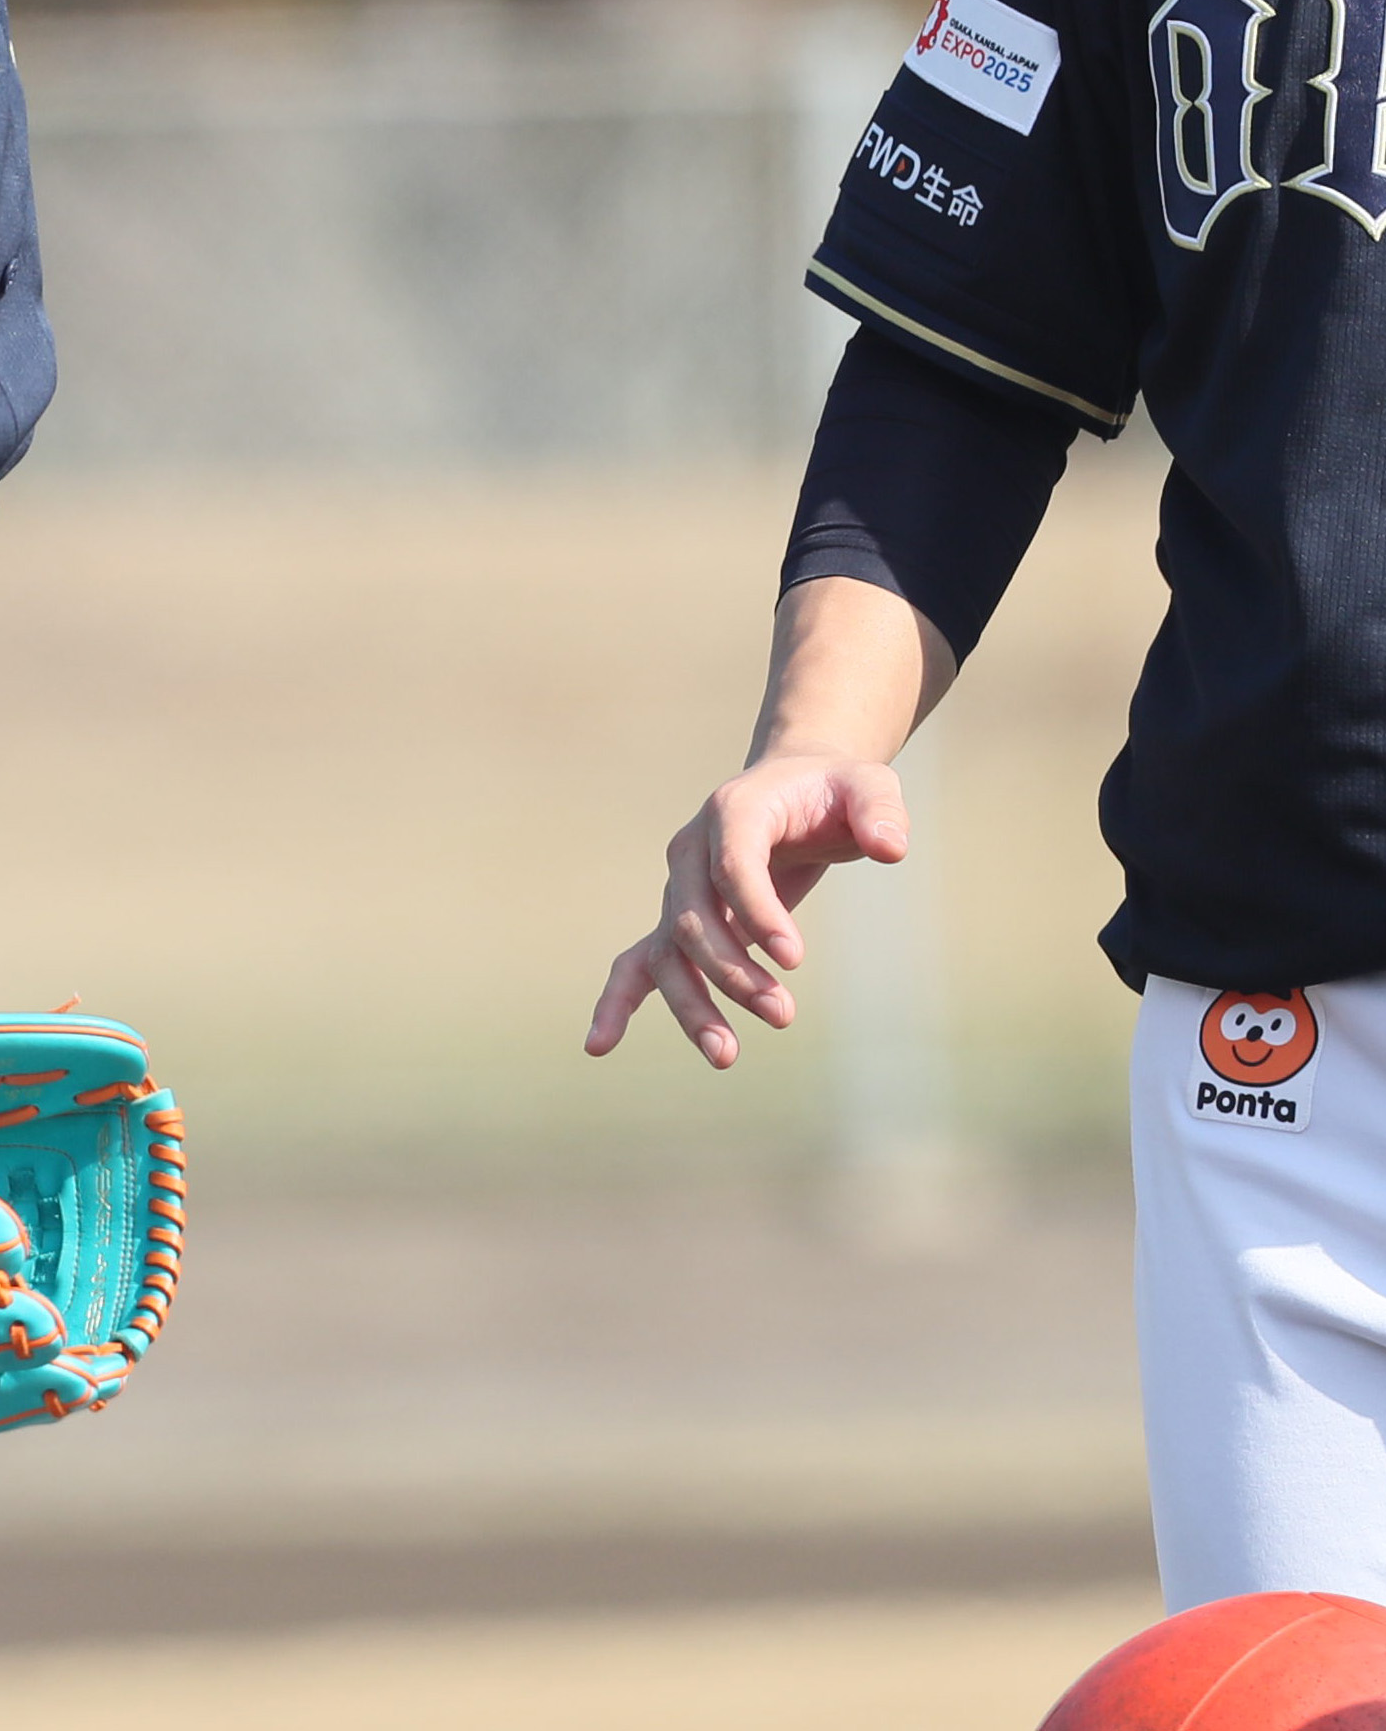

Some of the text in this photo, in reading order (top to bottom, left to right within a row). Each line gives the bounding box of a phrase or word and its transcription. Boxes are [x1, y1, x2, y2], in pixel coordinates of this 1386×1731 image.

[940, 30, 1034, 93] EXPO2025
[1007, 51, 1040, 74] JAPAN
[1197, 1082, 1296, 1123] Ponta
